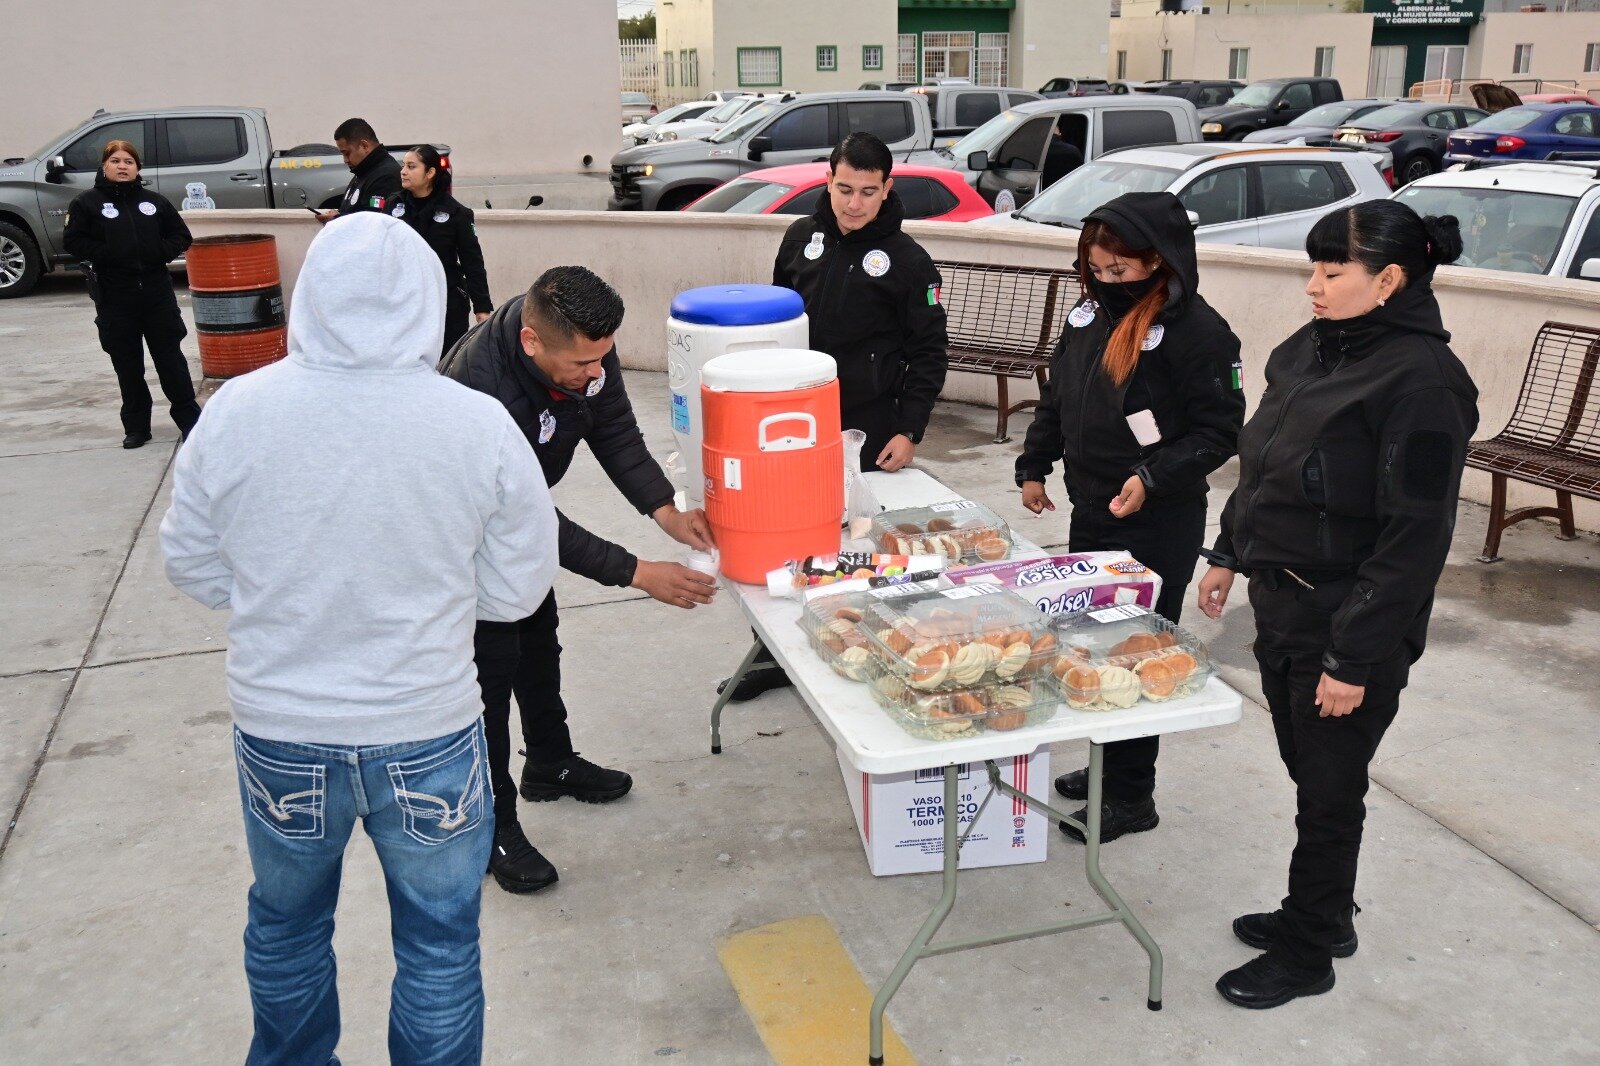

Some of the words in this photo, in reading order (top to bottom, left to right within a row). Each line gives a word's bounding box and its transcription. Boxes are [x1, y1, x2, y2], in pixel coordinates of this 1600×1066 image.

[1016, 559, 1098, 587] Delsey
[913, 796, 942, 805] VASO
[912, 818, 935, 827] 1000
